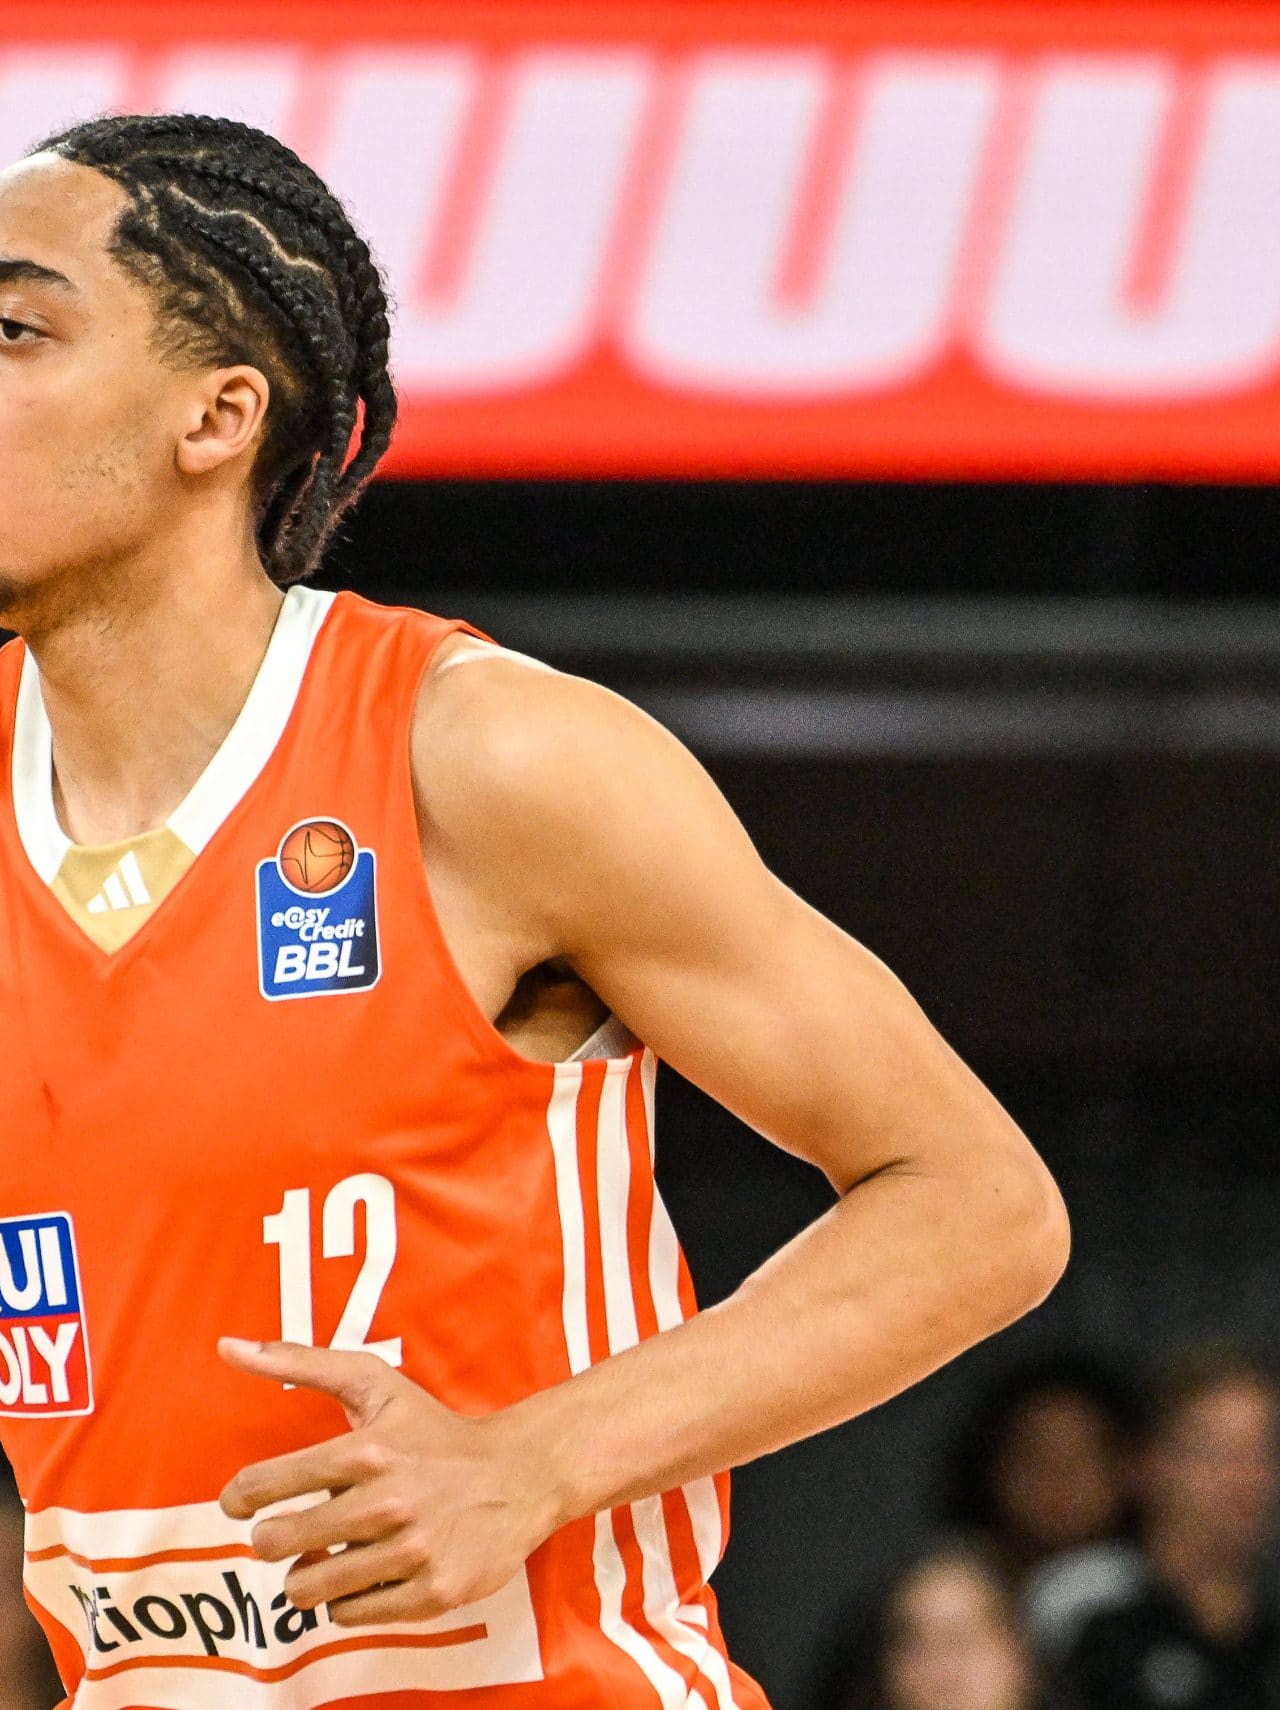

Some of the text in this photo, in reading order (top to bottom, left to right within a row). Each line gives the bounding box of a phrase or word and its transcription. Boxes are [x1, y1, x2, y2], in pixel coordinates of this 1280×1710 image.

[299, 919, 365, 942] Credit
[273, 939, 365, 984] BBL
[263, 1173, 402, 1390] 12
